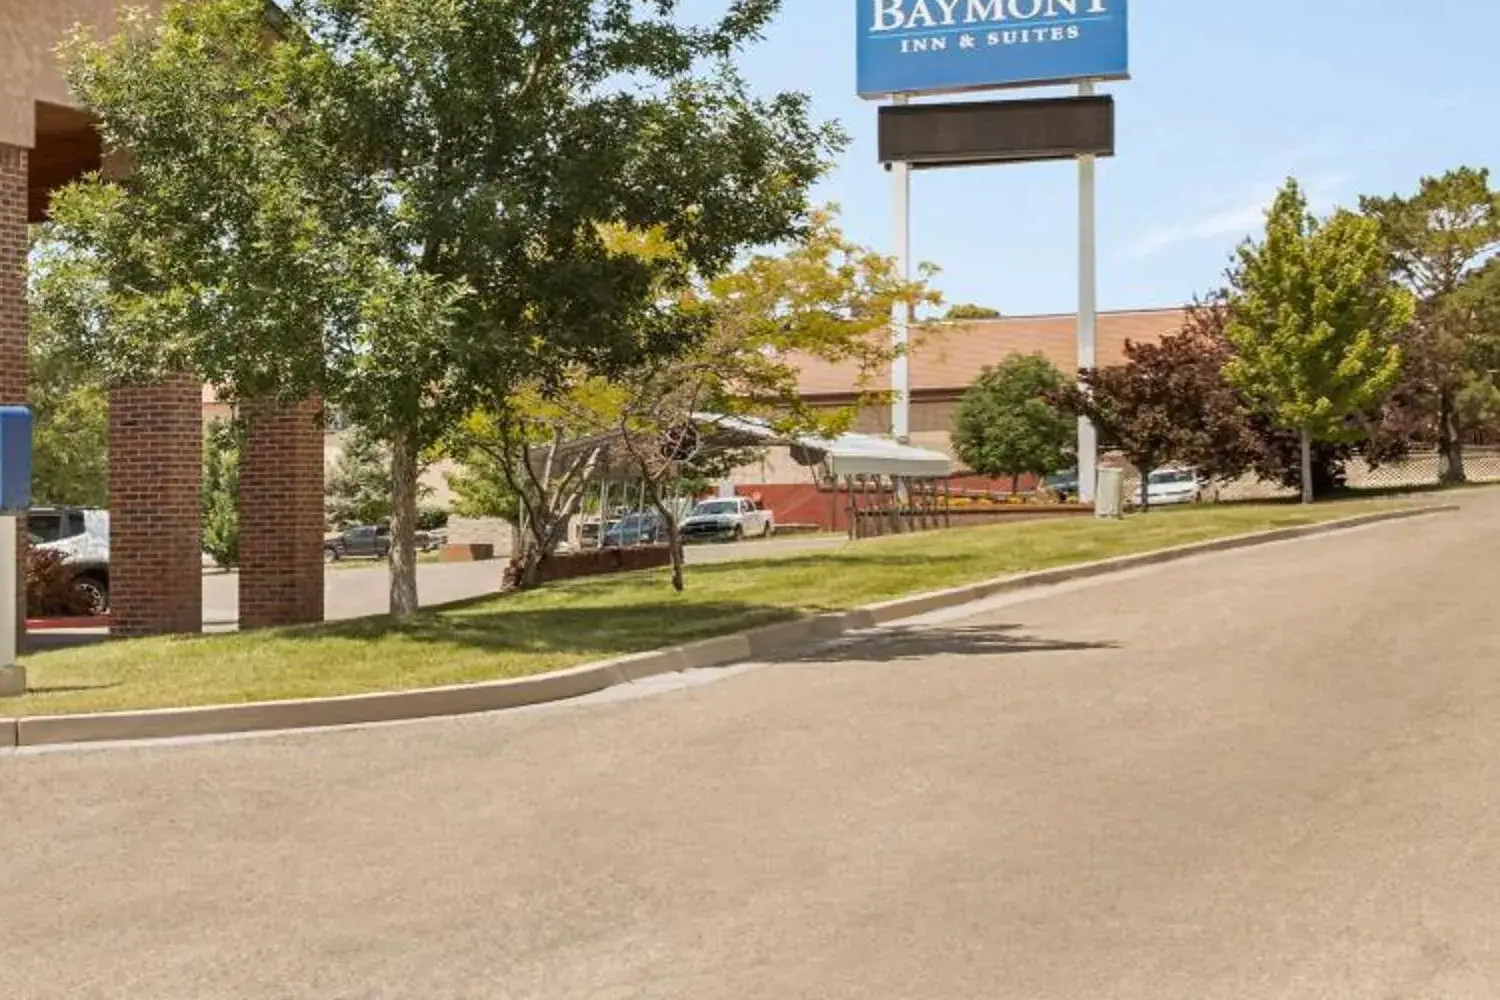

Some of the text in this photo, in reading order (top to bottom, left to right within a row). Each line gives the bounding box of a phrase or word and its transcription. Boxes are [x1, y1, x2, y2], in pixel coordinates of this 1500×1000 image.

[900, 25, 1080, 53] INN & SUITES
